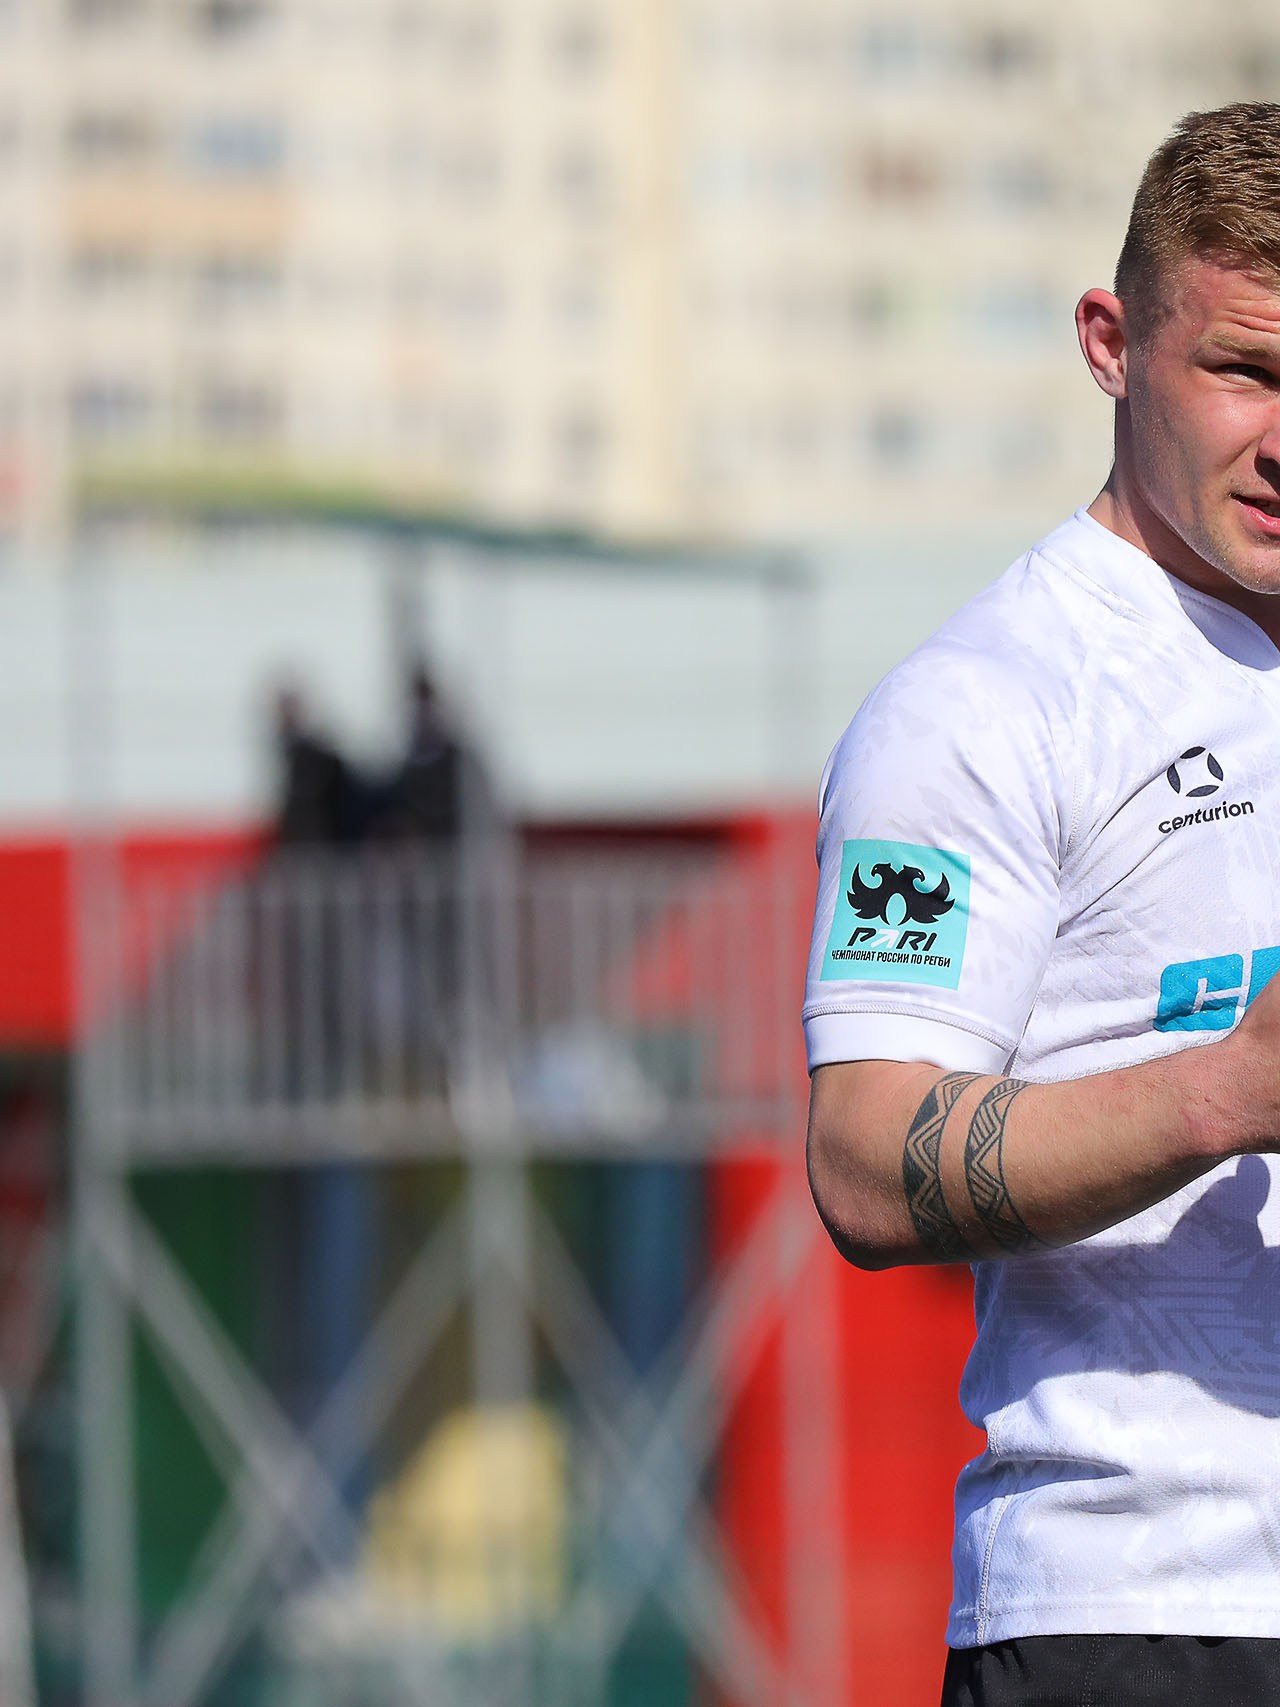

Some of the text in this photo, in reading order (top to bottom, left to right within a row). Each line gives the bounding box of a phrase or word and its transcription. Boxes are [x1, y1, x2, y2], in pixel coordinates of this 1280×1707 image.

[1158, 800, 1255, 834] centurion
[847, 927, 937, 952] PARI
[831, 950, 951, 968] ЧЕМПИОНАТ РОССИИ ПО РЕГБИ
